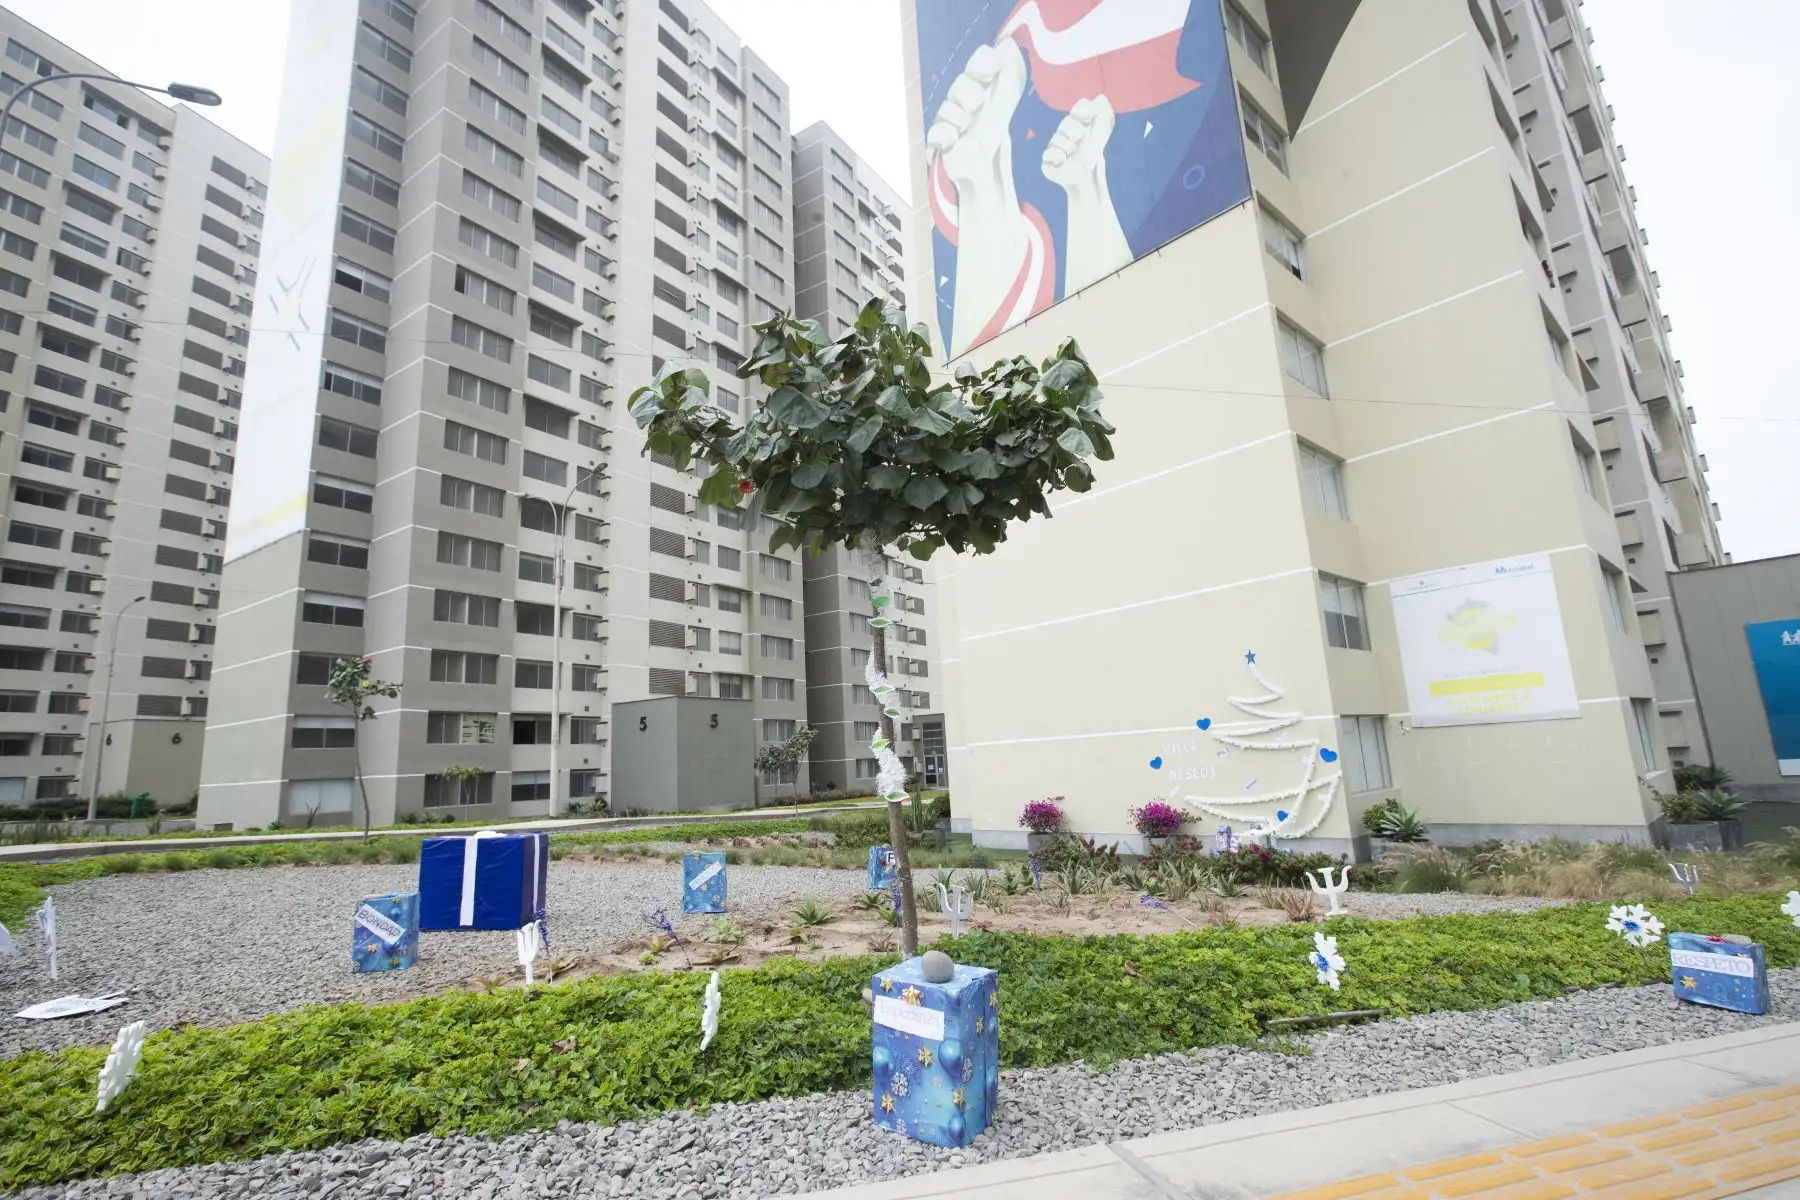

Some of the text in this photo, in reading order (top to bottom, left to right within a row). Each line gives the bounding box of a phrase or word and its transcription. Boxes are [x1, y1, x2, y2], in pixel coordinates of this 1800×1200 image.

[639, 716, 648, 732] 5
[711, 713, 719, 729] 5
[106, 733, 112, 747] 6
[171, 732, 182, 745] 6
[358, 909, 401, 937] BONDAD
[1672, 952, 1751, 974] RESPETO
